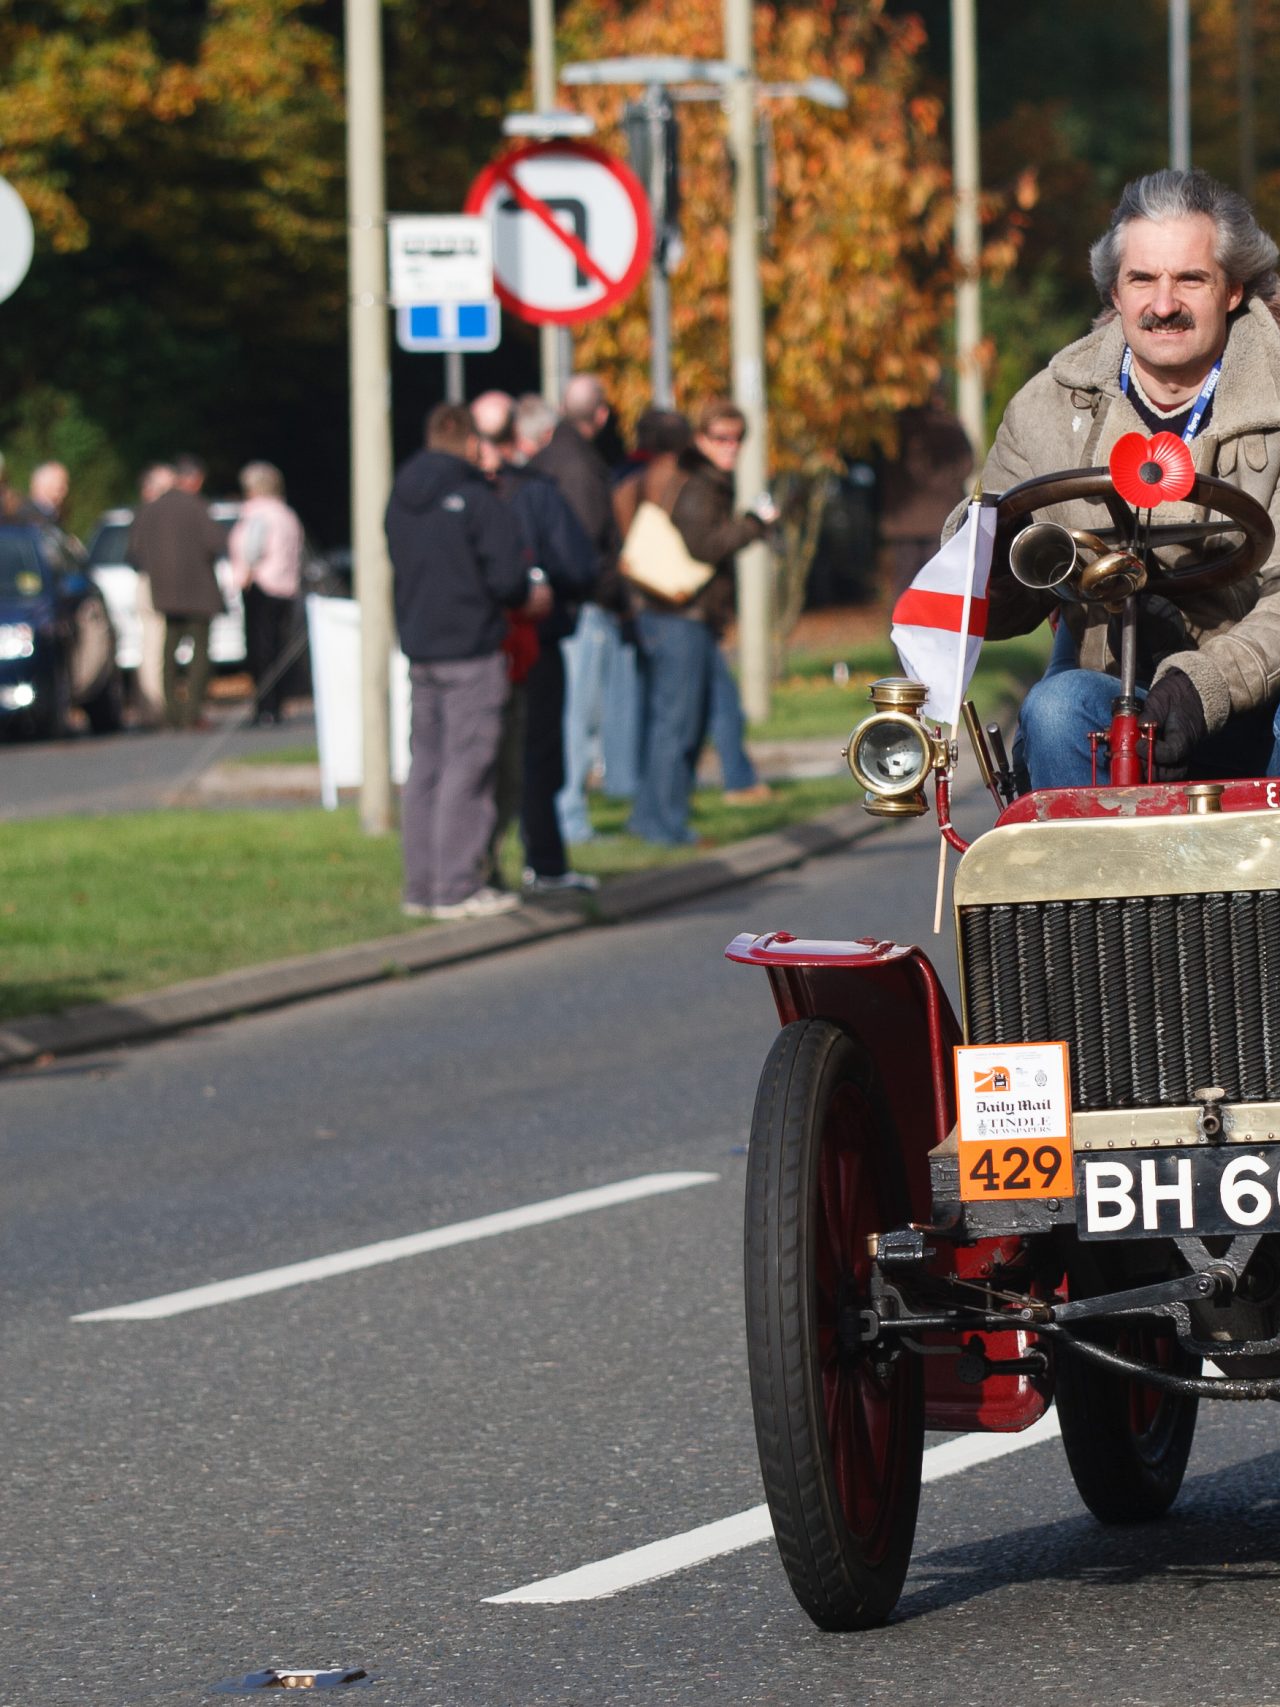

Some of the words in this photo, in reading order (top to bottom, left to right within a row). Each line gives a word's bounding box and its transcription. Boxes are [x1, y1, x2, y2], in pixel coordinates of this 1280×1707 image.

[976, 1100, 1015, 1116] Daily
[1018, 1099, 1051, 1112] Mail
[988, 1116, 1052, 1129] TINDLE
[989, 1126, 1052, 1135] NEWSPAPERS
[969, 1145, 1062, 1191] 429
[1085, 1158, 1194, 1233] BH
